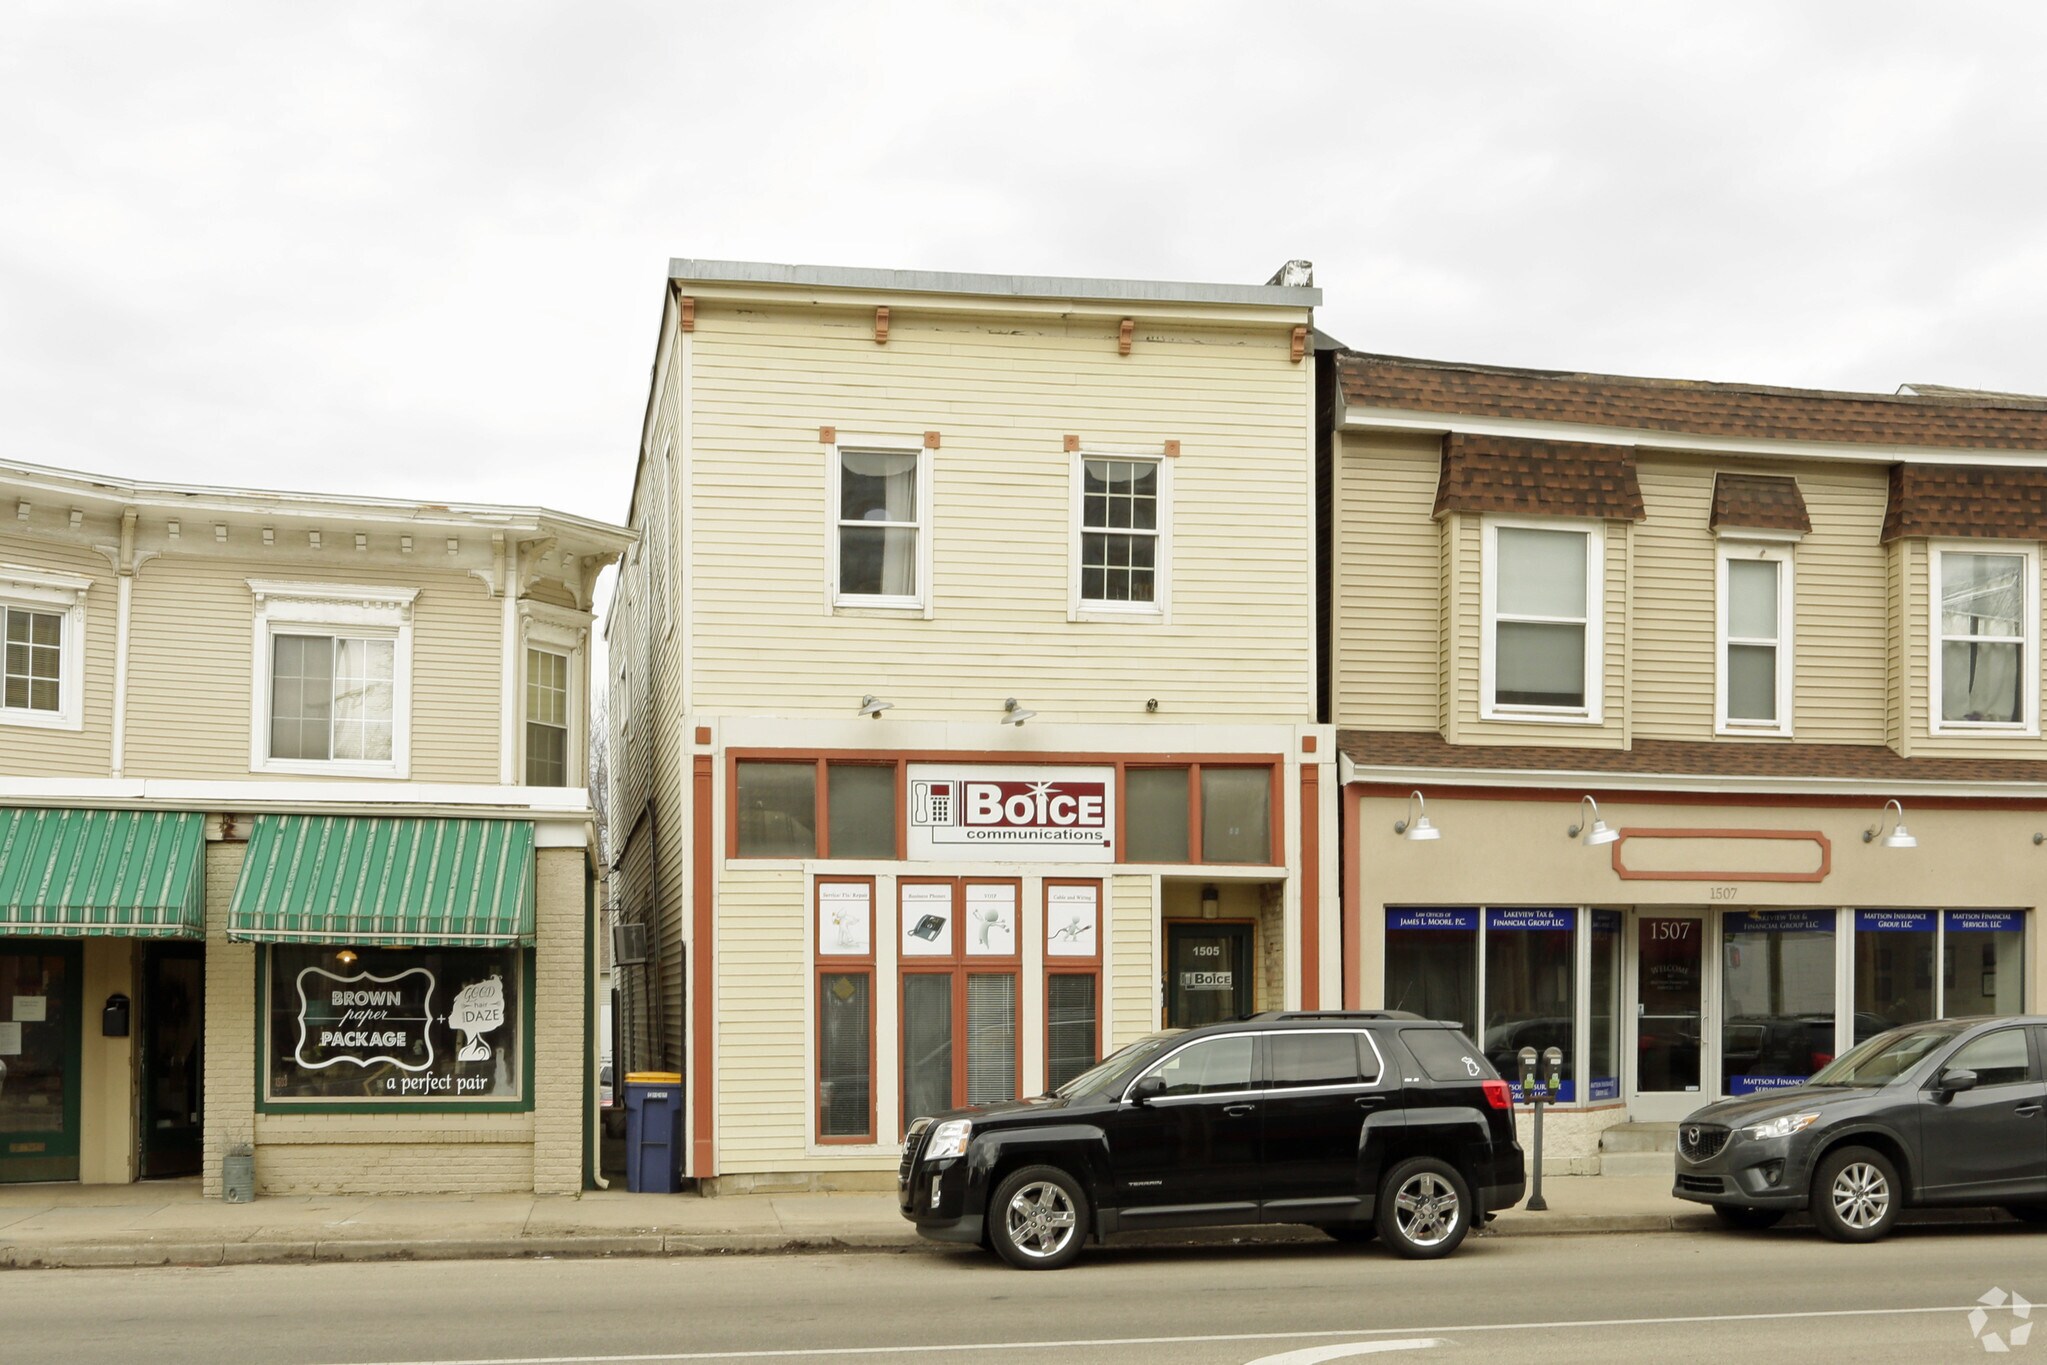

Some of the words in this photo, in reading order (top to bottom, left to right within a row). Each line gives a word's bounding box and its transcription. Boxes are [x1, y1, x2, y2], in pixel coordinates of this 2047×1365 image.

[966, 828, 1103, 840] communications
[1710, 888, 1737, 899] 1507
[1503, 910, 1534, 918] LAKEVIEW
[1536, 910, 1547, 918] TAX
[1548, 910, 1554, 918] &
[1400, 917, 1419, 926] JAMES
[1493, 918, 1527, 927] FINANCIAL
[1527, 919, 1550, 927] GROUP
[1552, 919, 1565, 927] LLC
[1901, 920, 1913, 928] LLC
[1990, 920, 2002, 928] LLC
[1650, 922, 1691, 940] 1507
[1193, 946, 1220, 956] 1505
[332, 991, 401, 1006] BROWN
[338, 1006, 388, 1028] paper
[465, 1009, 500, 1023] DAZE
[321, 1032, 407, 1047] PACKAGE
[386, 1079, 396, 1090] a
[401, 1072, 452, 1095] perfect
[456, 1074, 488, 1095] pair
